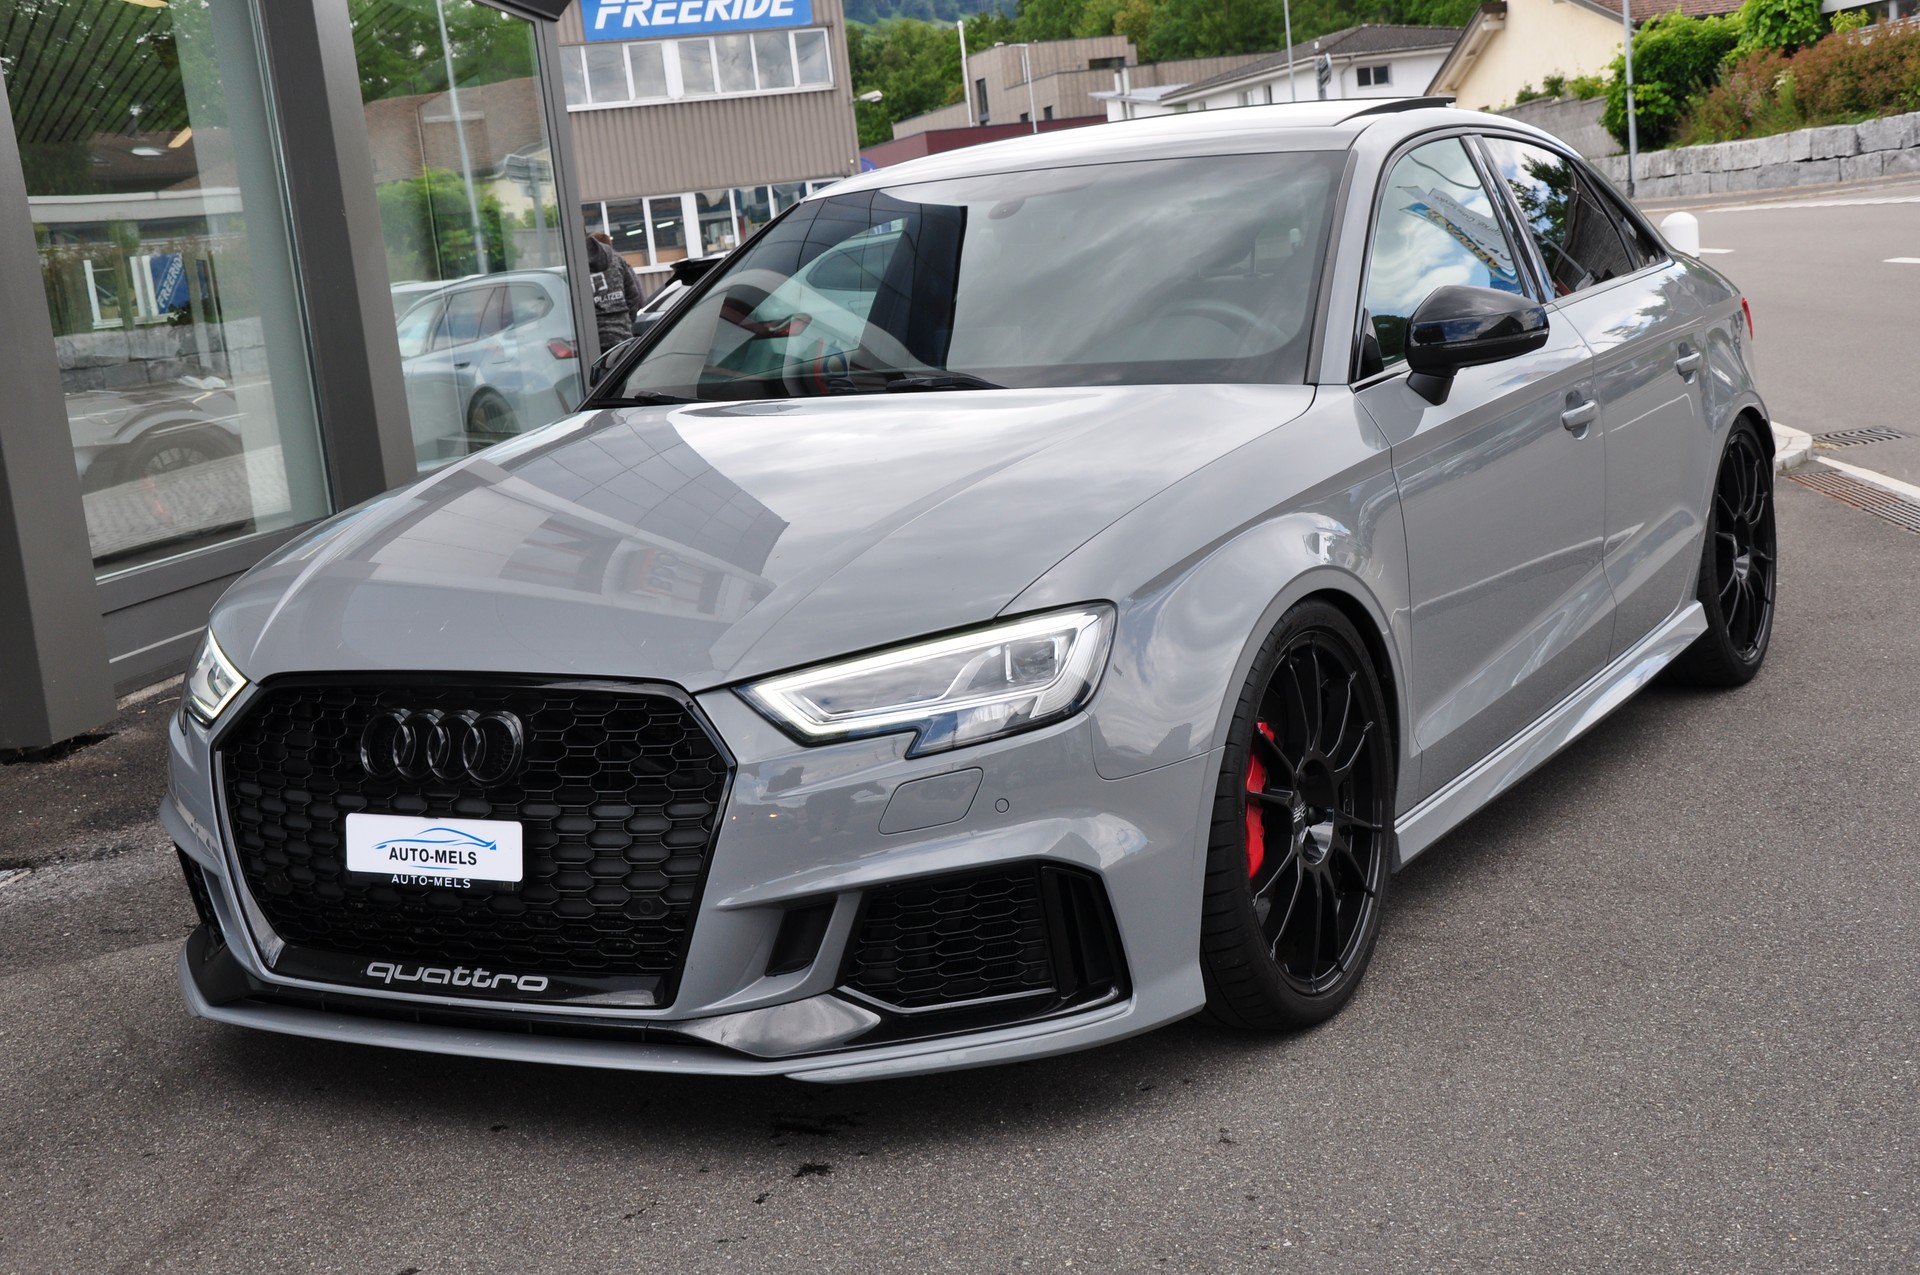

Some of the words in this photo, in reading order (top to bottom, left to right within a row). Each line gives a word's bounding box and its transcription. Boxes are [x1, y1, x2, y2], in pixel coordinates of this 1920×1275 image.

[594, 0, 794, 30] FREERIDE
[389, 847, 477, 866] AUTO-MELS
[391, 874, 471, 889] AUTO-MELS
[366, 961, 549, 992] quattro
